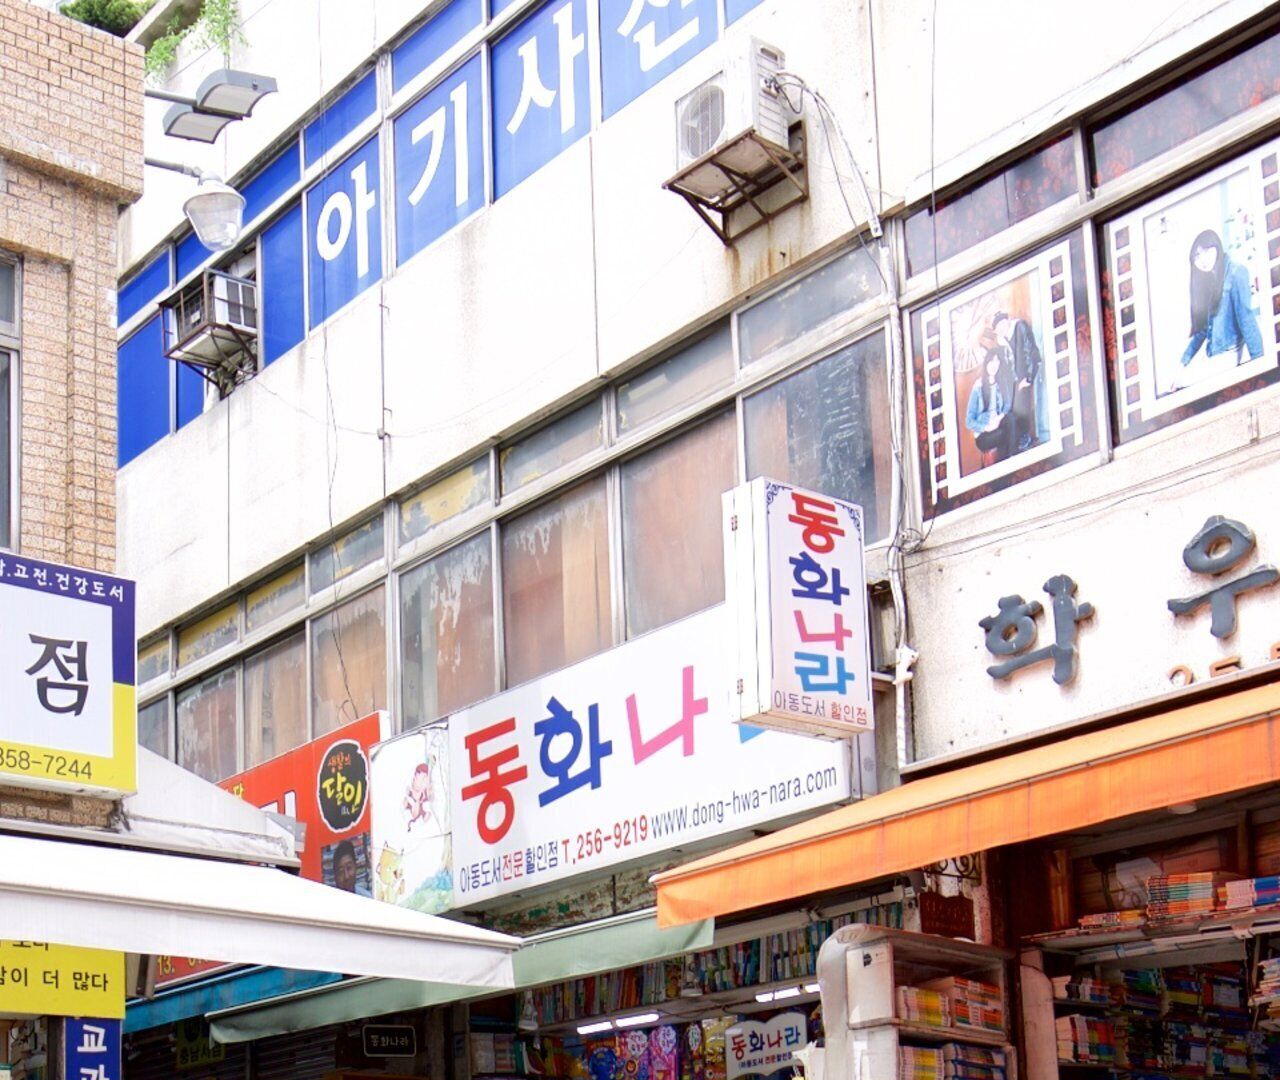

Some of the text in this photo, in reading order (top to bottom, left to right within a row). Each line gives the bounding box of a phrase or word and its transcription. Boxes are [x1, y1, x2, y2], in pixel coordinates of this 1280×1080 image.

[787, 491, 856, 695] 동화나라
[773, 690, 868, 726] 아동도서 할인점
[460, 665, 710, 846] 동화나
[321, 772, 363, 814] 달인
[41, 969, 60, 989] 더
[72, 972, 109, 992] 많다
[731, 1024, 801, 1061] 동화나라
